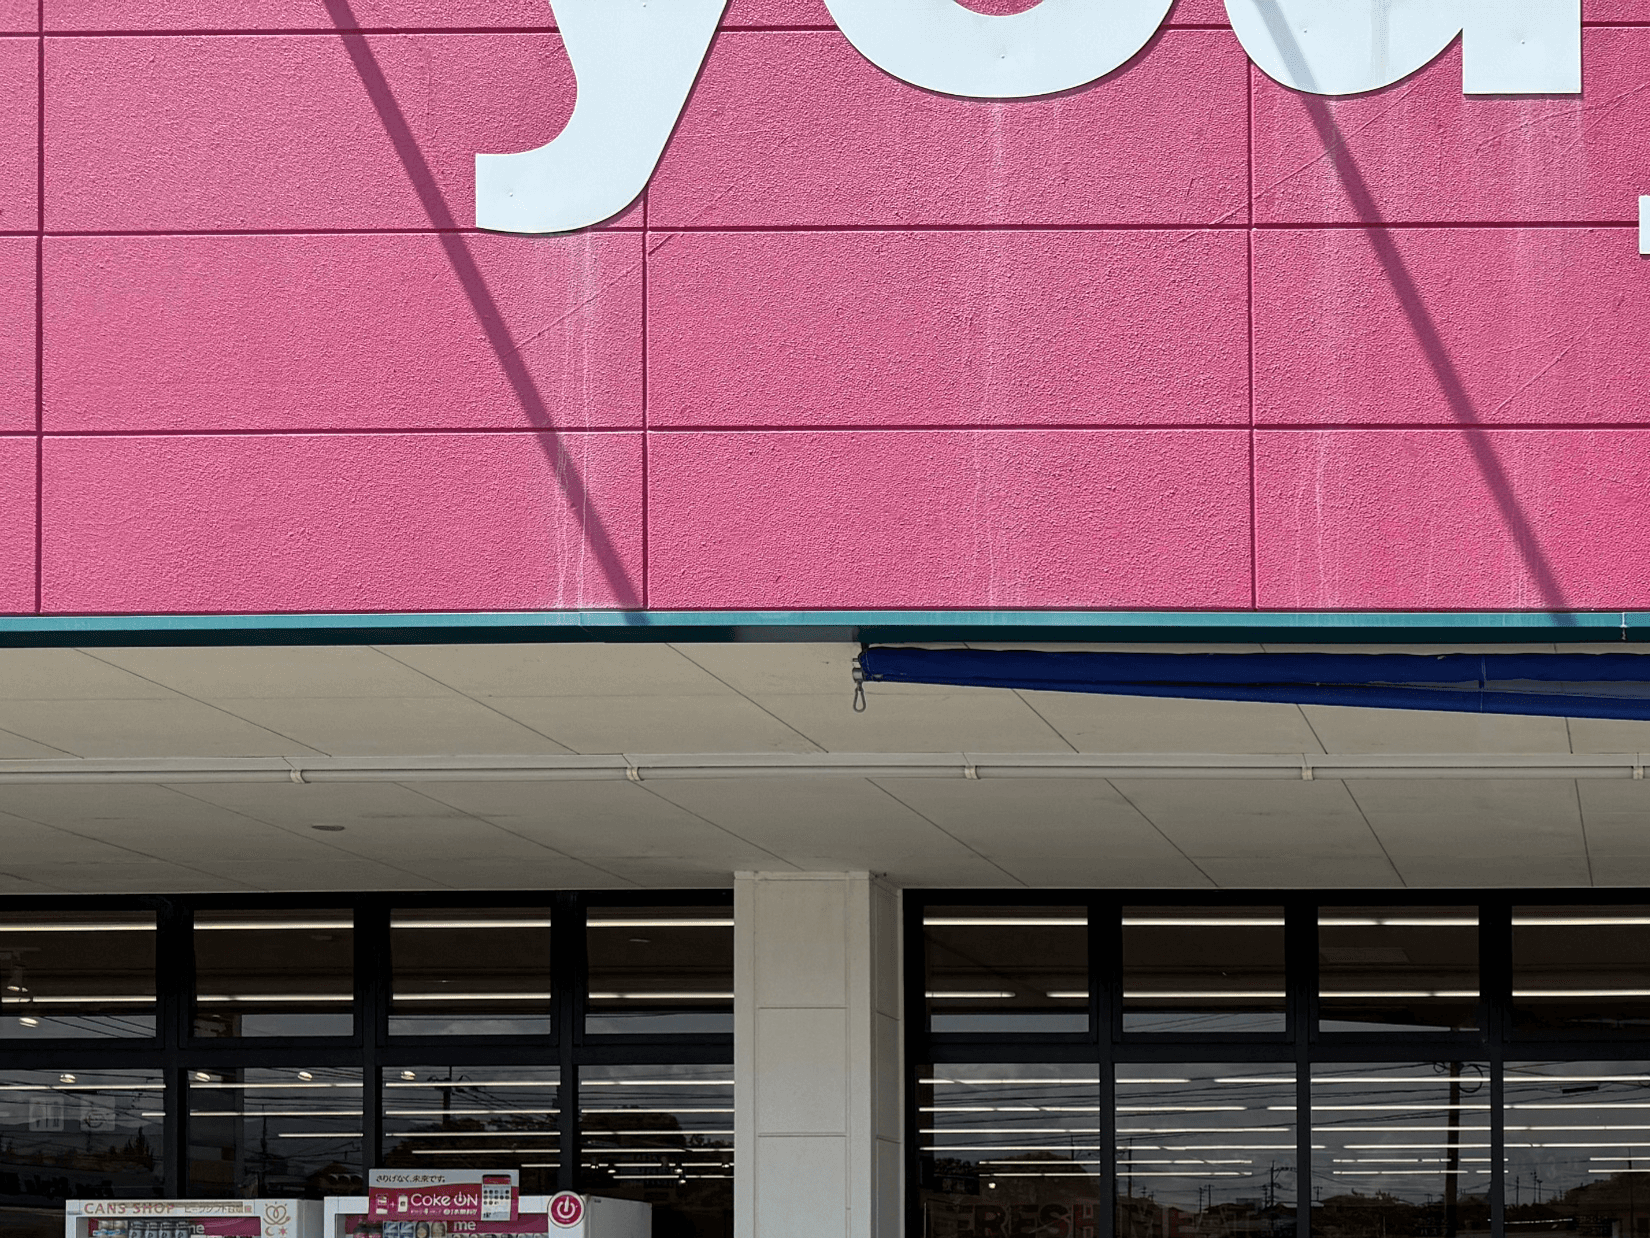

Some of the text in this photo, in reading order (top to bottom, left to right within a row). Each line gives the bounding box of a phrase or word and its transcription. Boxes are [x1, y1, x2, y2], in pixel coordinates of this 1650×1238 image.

[410, 1191, 478, 1207] Coke ON
[84, 1202, 175, 1215] CANS SHOP
